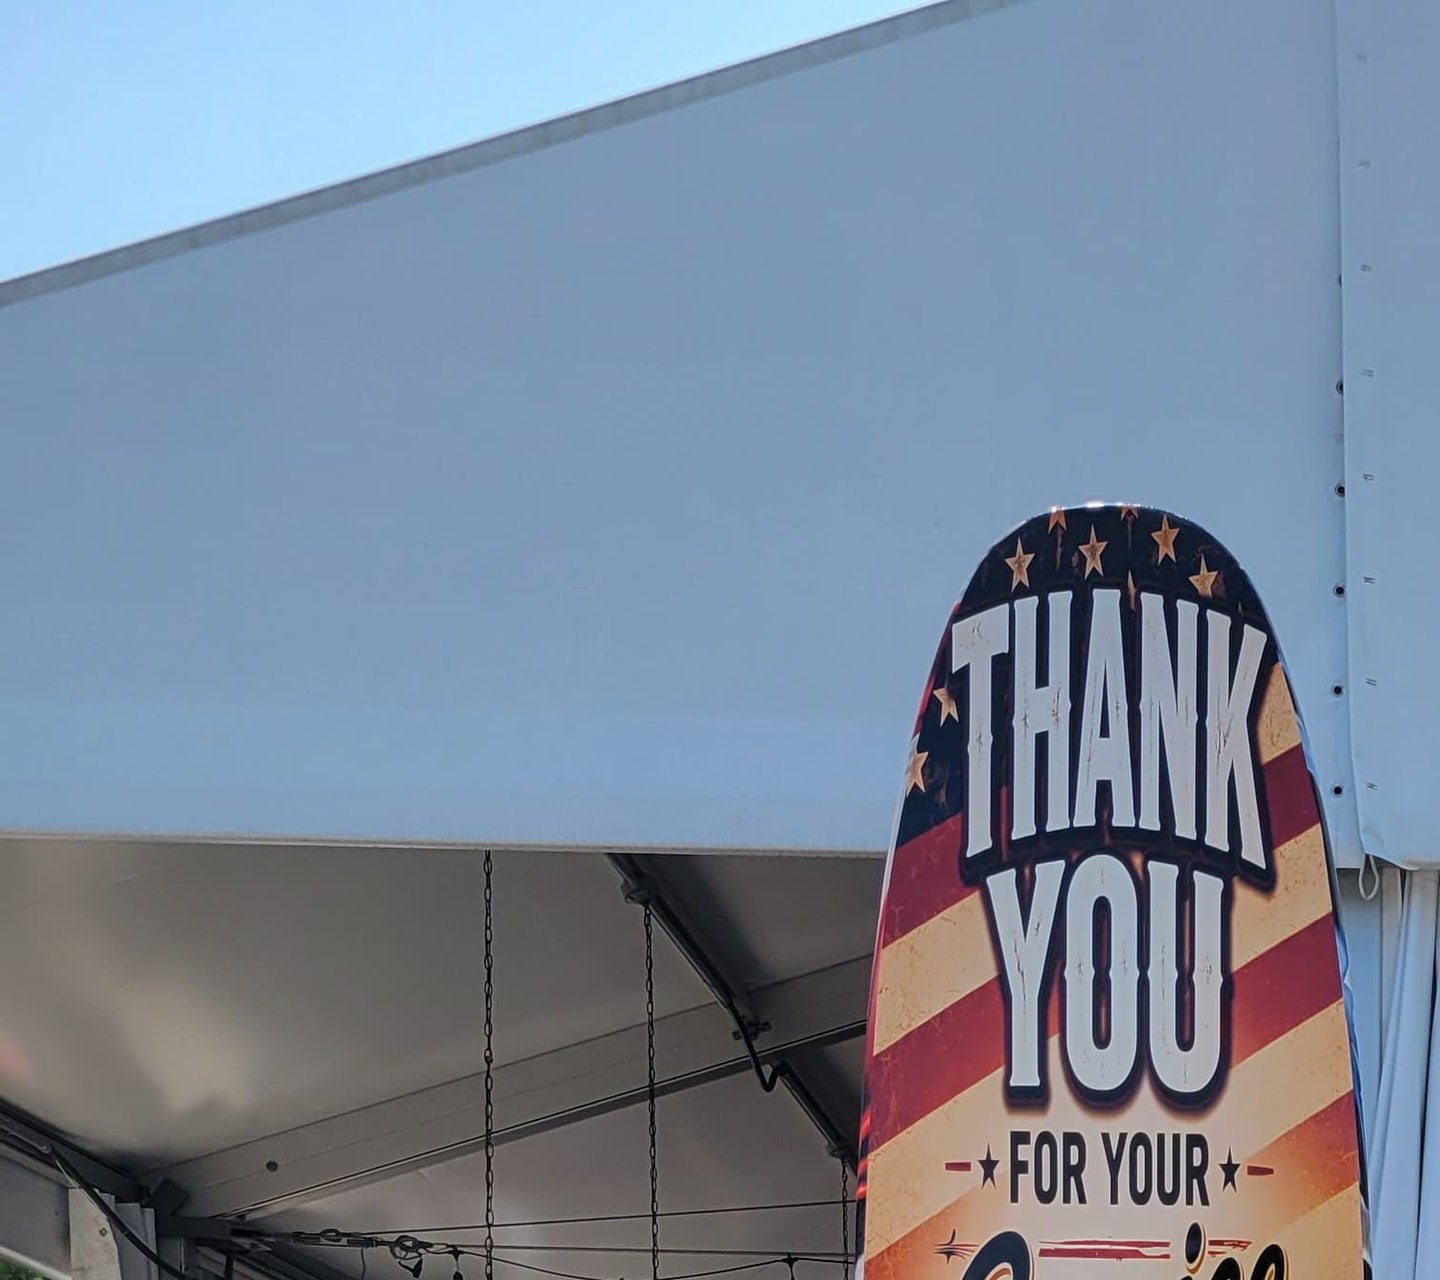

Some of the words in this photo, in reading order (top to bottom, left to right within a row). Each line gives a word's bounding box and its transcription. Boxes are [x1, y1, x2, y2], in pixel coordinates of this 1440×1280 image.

[951, 588, 1268, 871] THANK
[986, 854, 1225, 1092] YOU
[1009, 1130, 1088, 1205] FOR
[1101, 1132, 1210, 1207] YOUR
